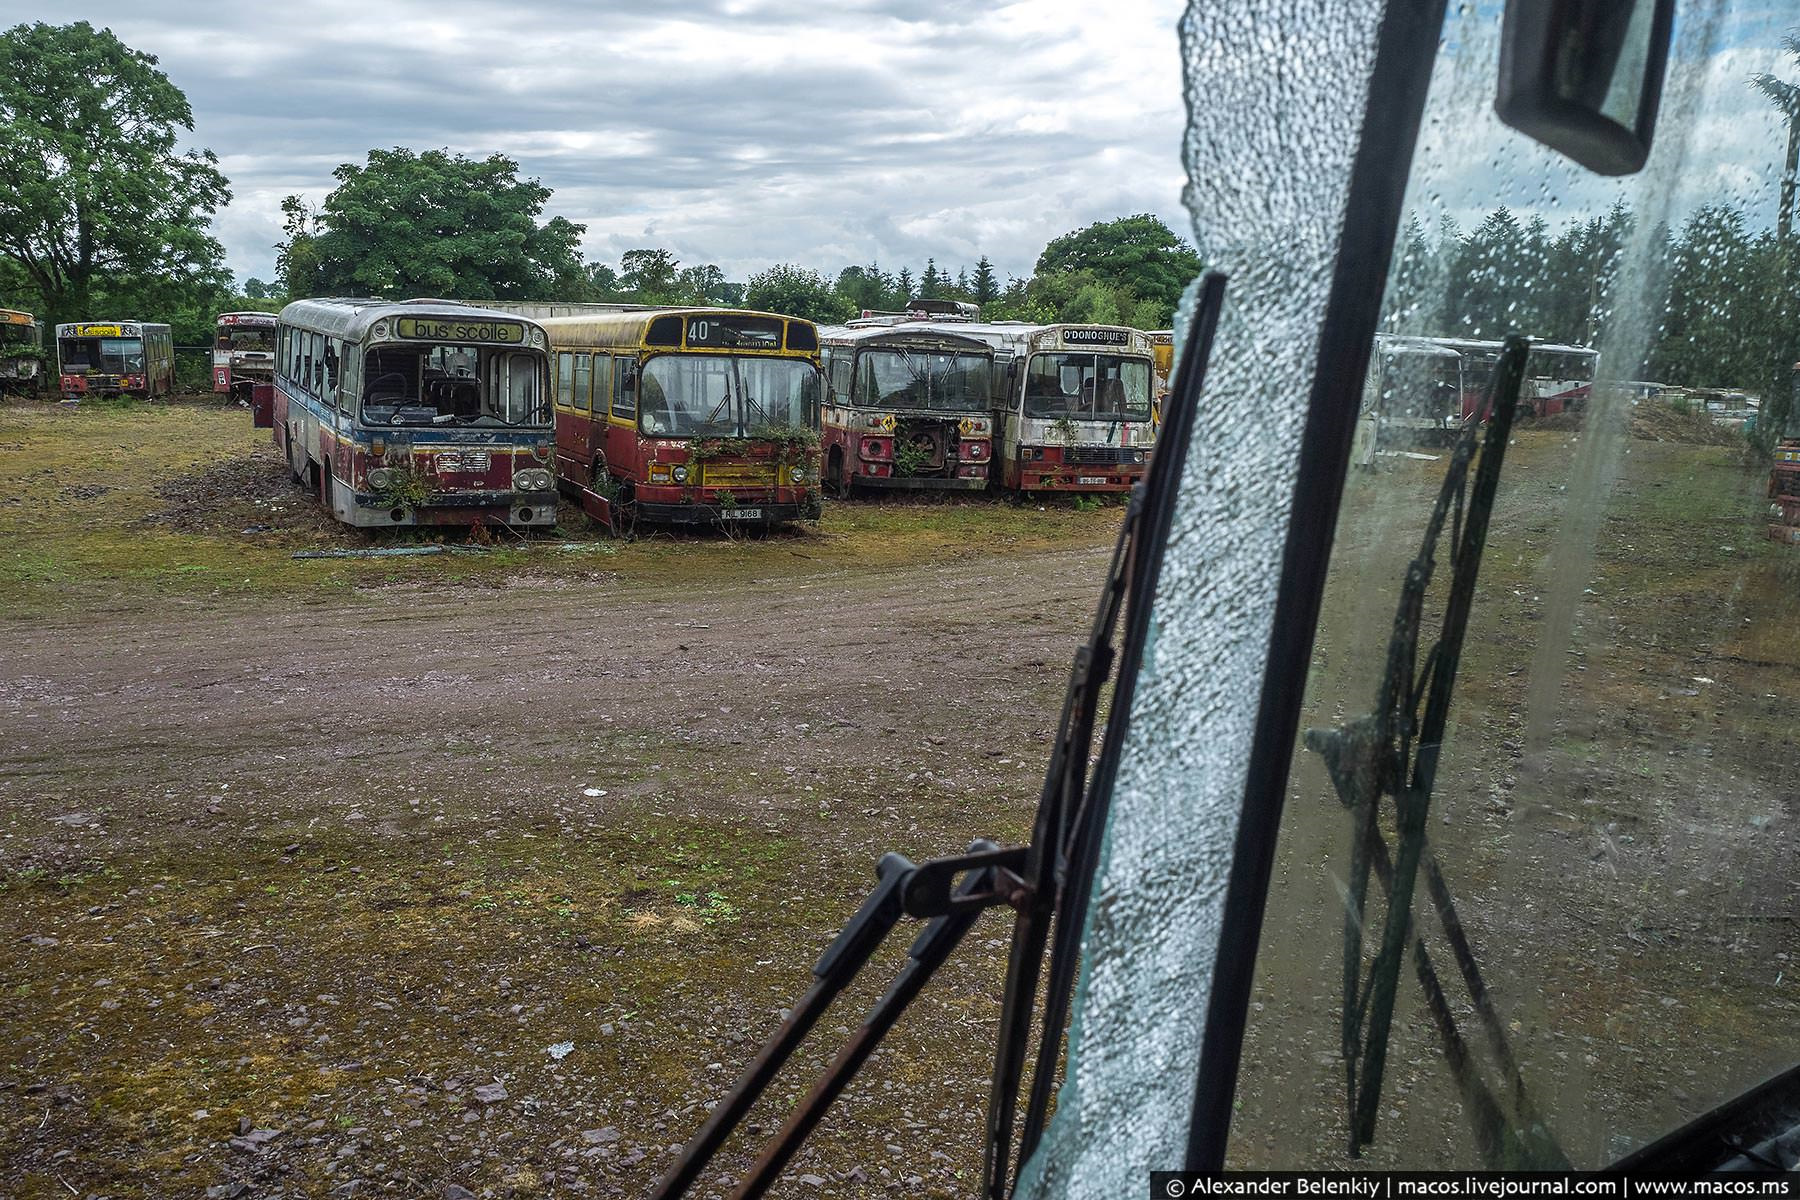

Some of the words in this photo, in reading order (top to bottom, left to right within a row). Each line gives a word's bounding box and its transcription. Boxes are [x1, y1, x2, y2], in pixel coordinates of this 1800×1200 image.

[415, 320, 449, 338] bus
[455, 323, 509, 341] scoile
[688, 321, 708, 341] 40
[1063, 330, 1127, 342] O'DONOGHUE'S
[740, 510, 758, 518] 9168
